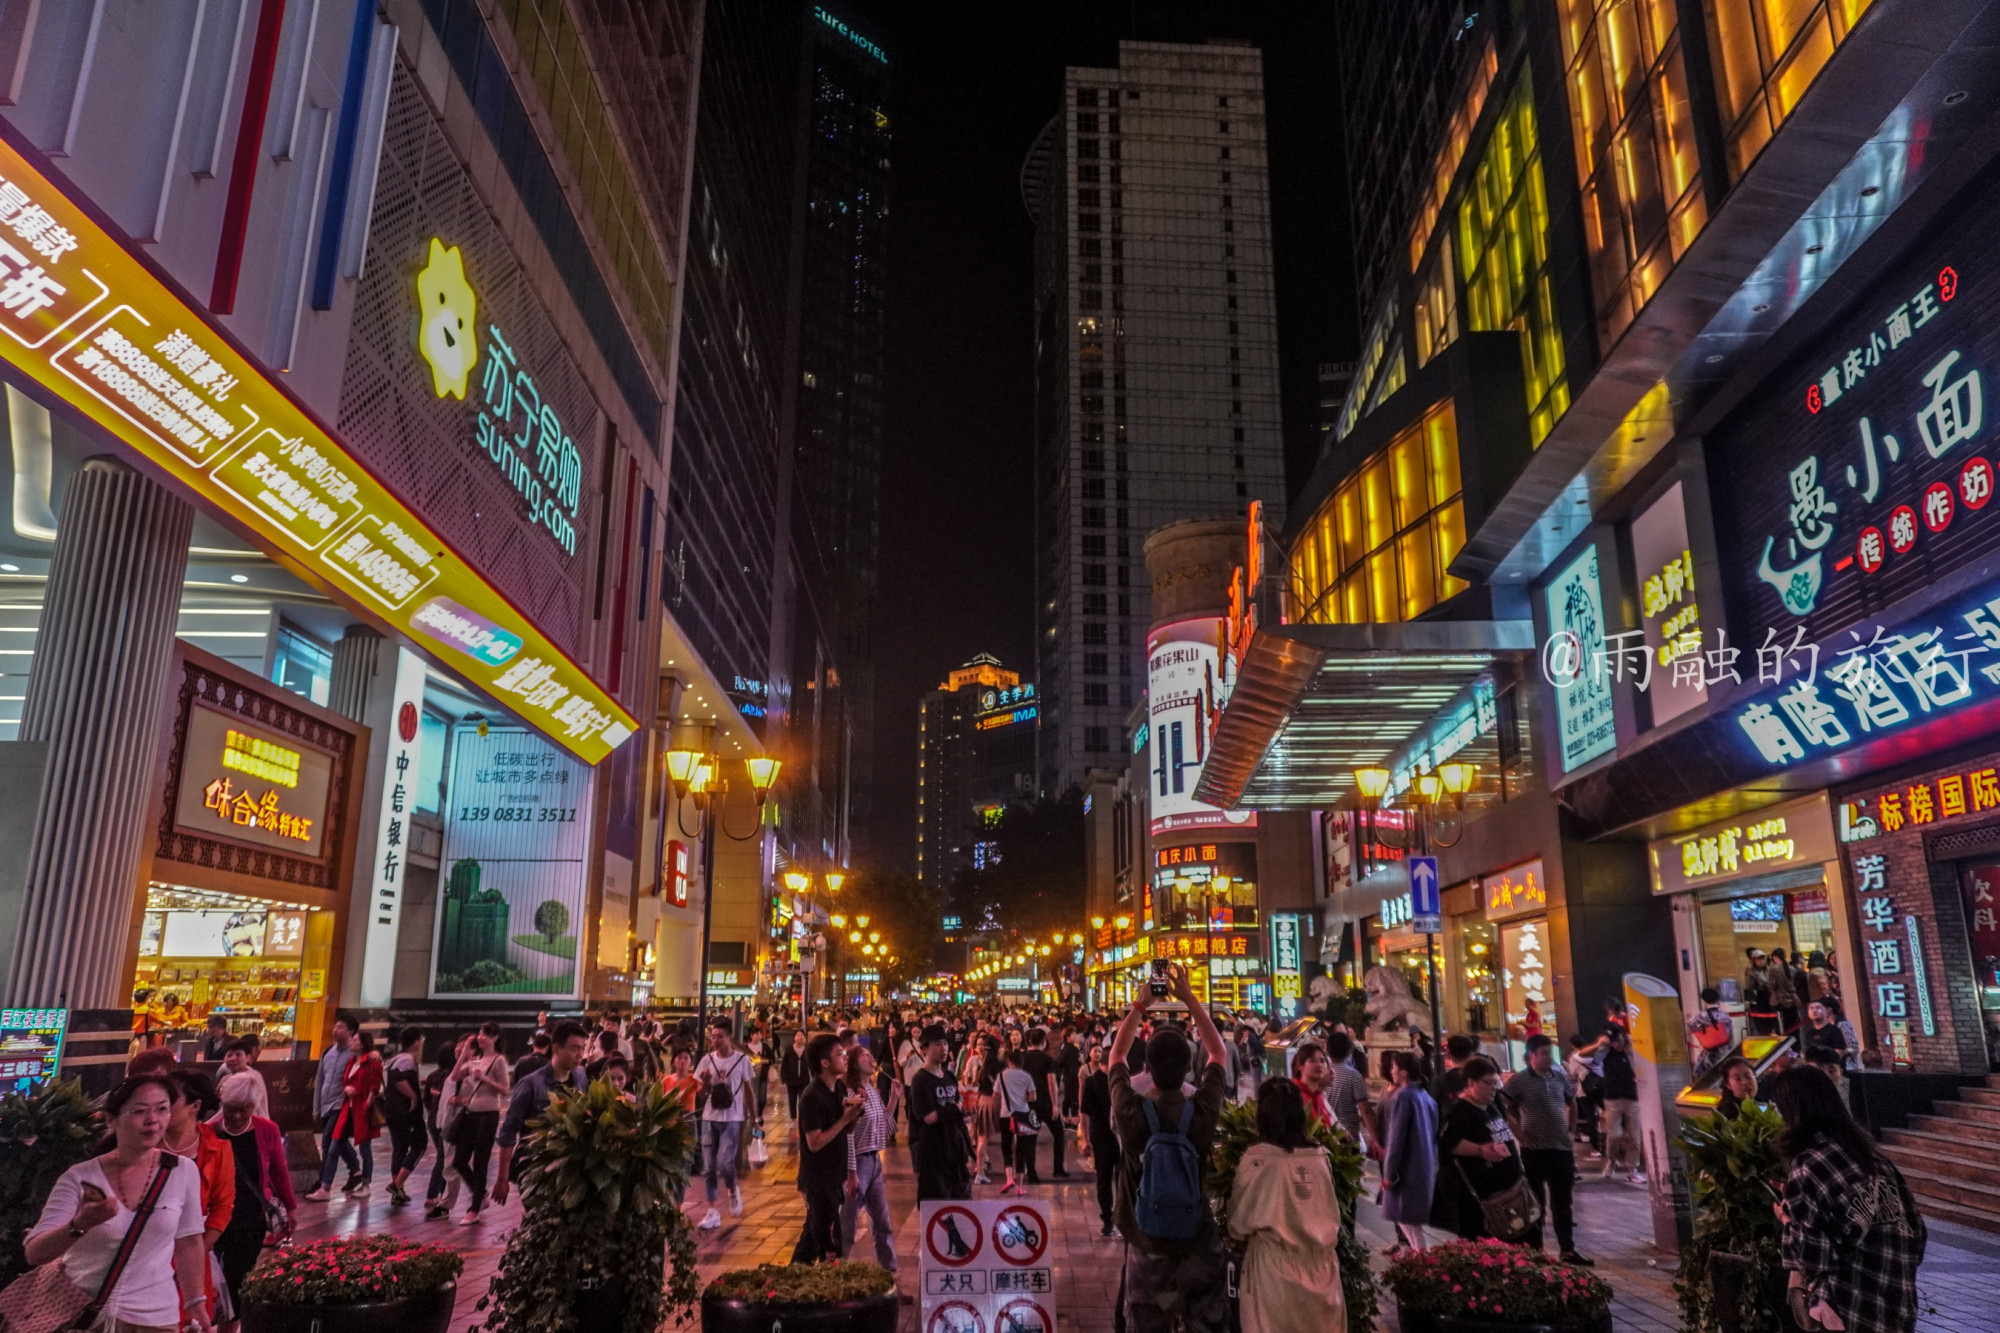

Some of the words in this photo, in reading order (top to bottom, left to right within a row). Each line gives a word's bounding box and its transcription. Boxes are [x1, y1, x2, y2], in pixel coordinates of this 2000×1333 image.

[849, 30, 888, 64] HOTEL
[0, 176, 78, 263] 量爆款
[153, 328, 239, 402] 满赠豪礼
[1820, 284, 1939, 407] 重庆小面王
[476, 412, 576, 557] suning.com
[1788, 350, 1982, 561] 愚小面
[1858, 464, 1990, 570] 传统作坊
[476, 769, 569, 785] 让城市多点绿
[494, 752, 555, 767] 低碳出行
[383, 750, 411, 884] 中信银行
[459, 807, 489, 822] 139
[493, 807, 532, 822] 0831
[538, 808, 577, 822] 3511
[1879, 768, 2000, 832] 标榜国际
[1160, 845, 1217, 867] 重庆小面
[1855, 854, 1907, 1017] 芳华酒店
[940, 1273, 974, 1292] 犬只
[995, 1272, 1048, 1291] 摩托车
